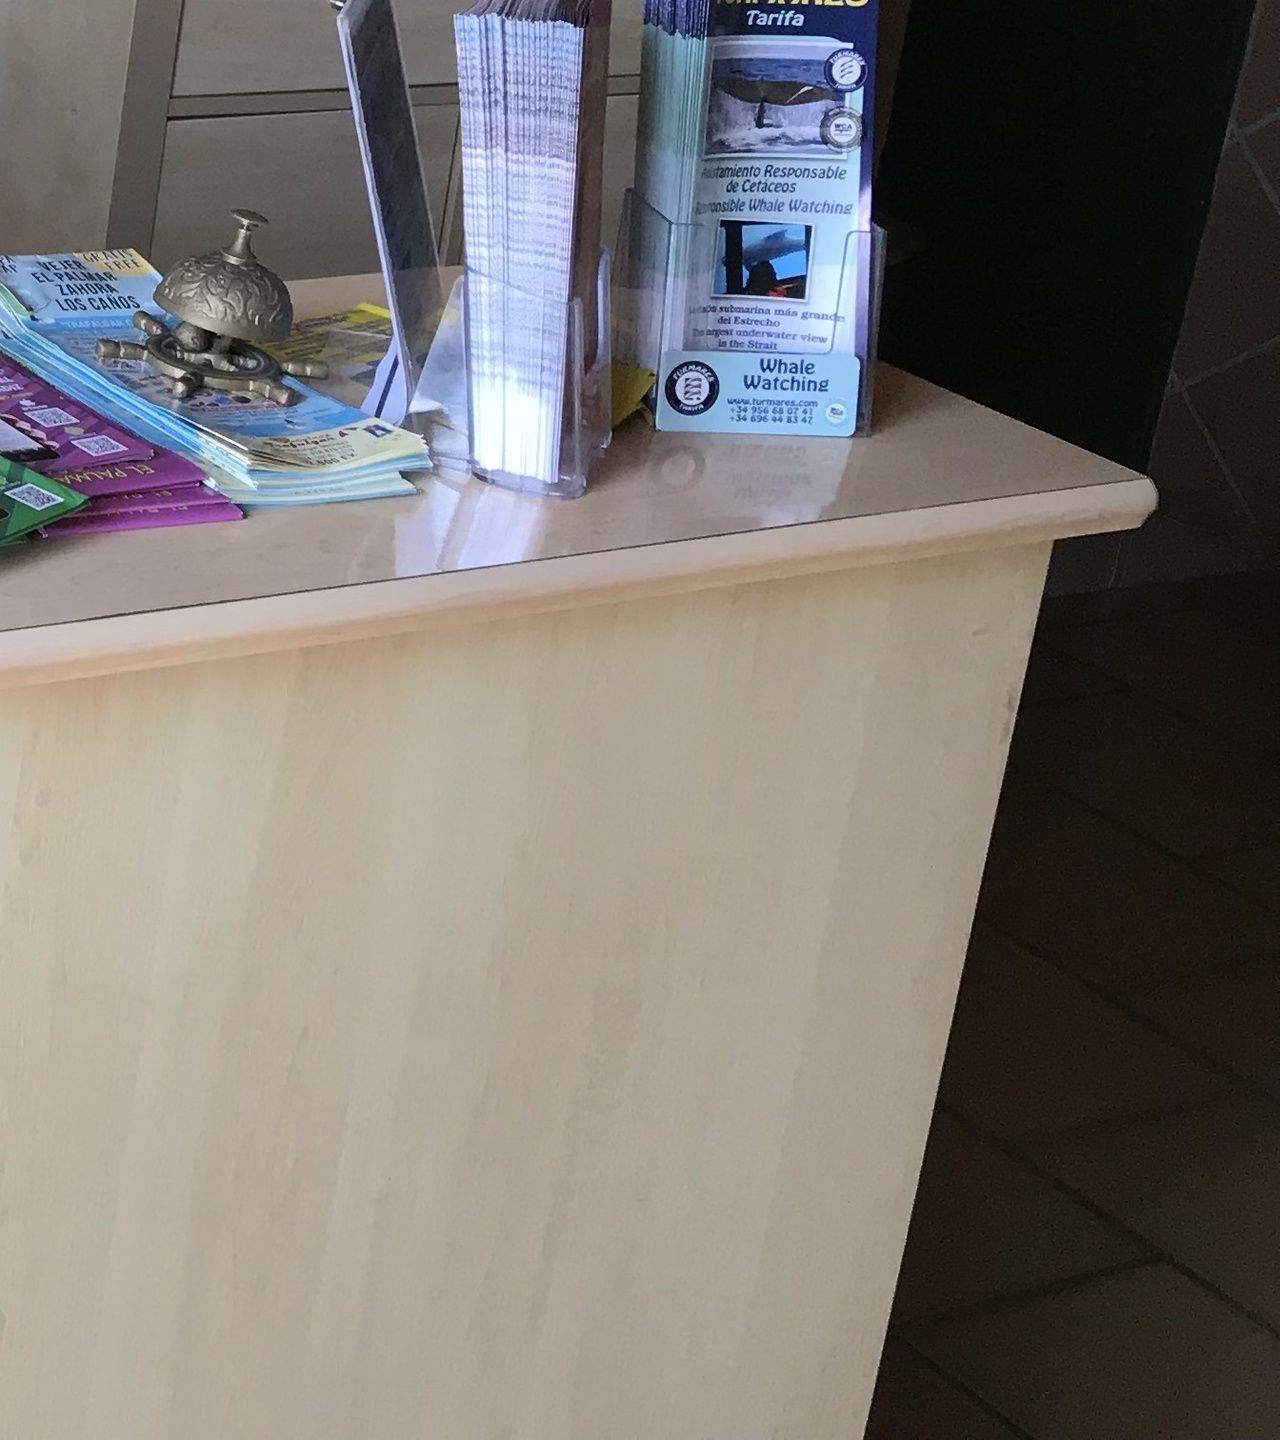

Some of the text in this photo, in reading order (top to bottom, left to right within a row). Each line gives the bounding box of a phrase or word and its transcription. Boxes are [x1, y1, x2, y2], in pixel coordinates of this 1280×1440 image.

[746, 10, 805, 26] Tarifa
[764, 165, 847, 179] Responsable
[726, 179, 796, 193] de Cetáceos
[749, 199, 853, 214] Whale Watching
[39, 260, 87, 270] VEJER
[32, 271, 118, 283] EL PALMAR
[54, 284, 120, 296] ZAHORA
[55, 295, 140, 310] LOS CAÑOS
[719, 305, 797, 317] submarina más
[734, 318, 780, 327] Estrecho
[736, 329, 828, 344] underwater view
[747, 340, 777, 350] Strait
[760, 358, 815, 375] Whale
[743, 375, 830, 392] Watching
[726, 397, 818, 408] www.turmares.com
[751, 407, 769, 415] 956
[750, 415, 768, 423] 696
